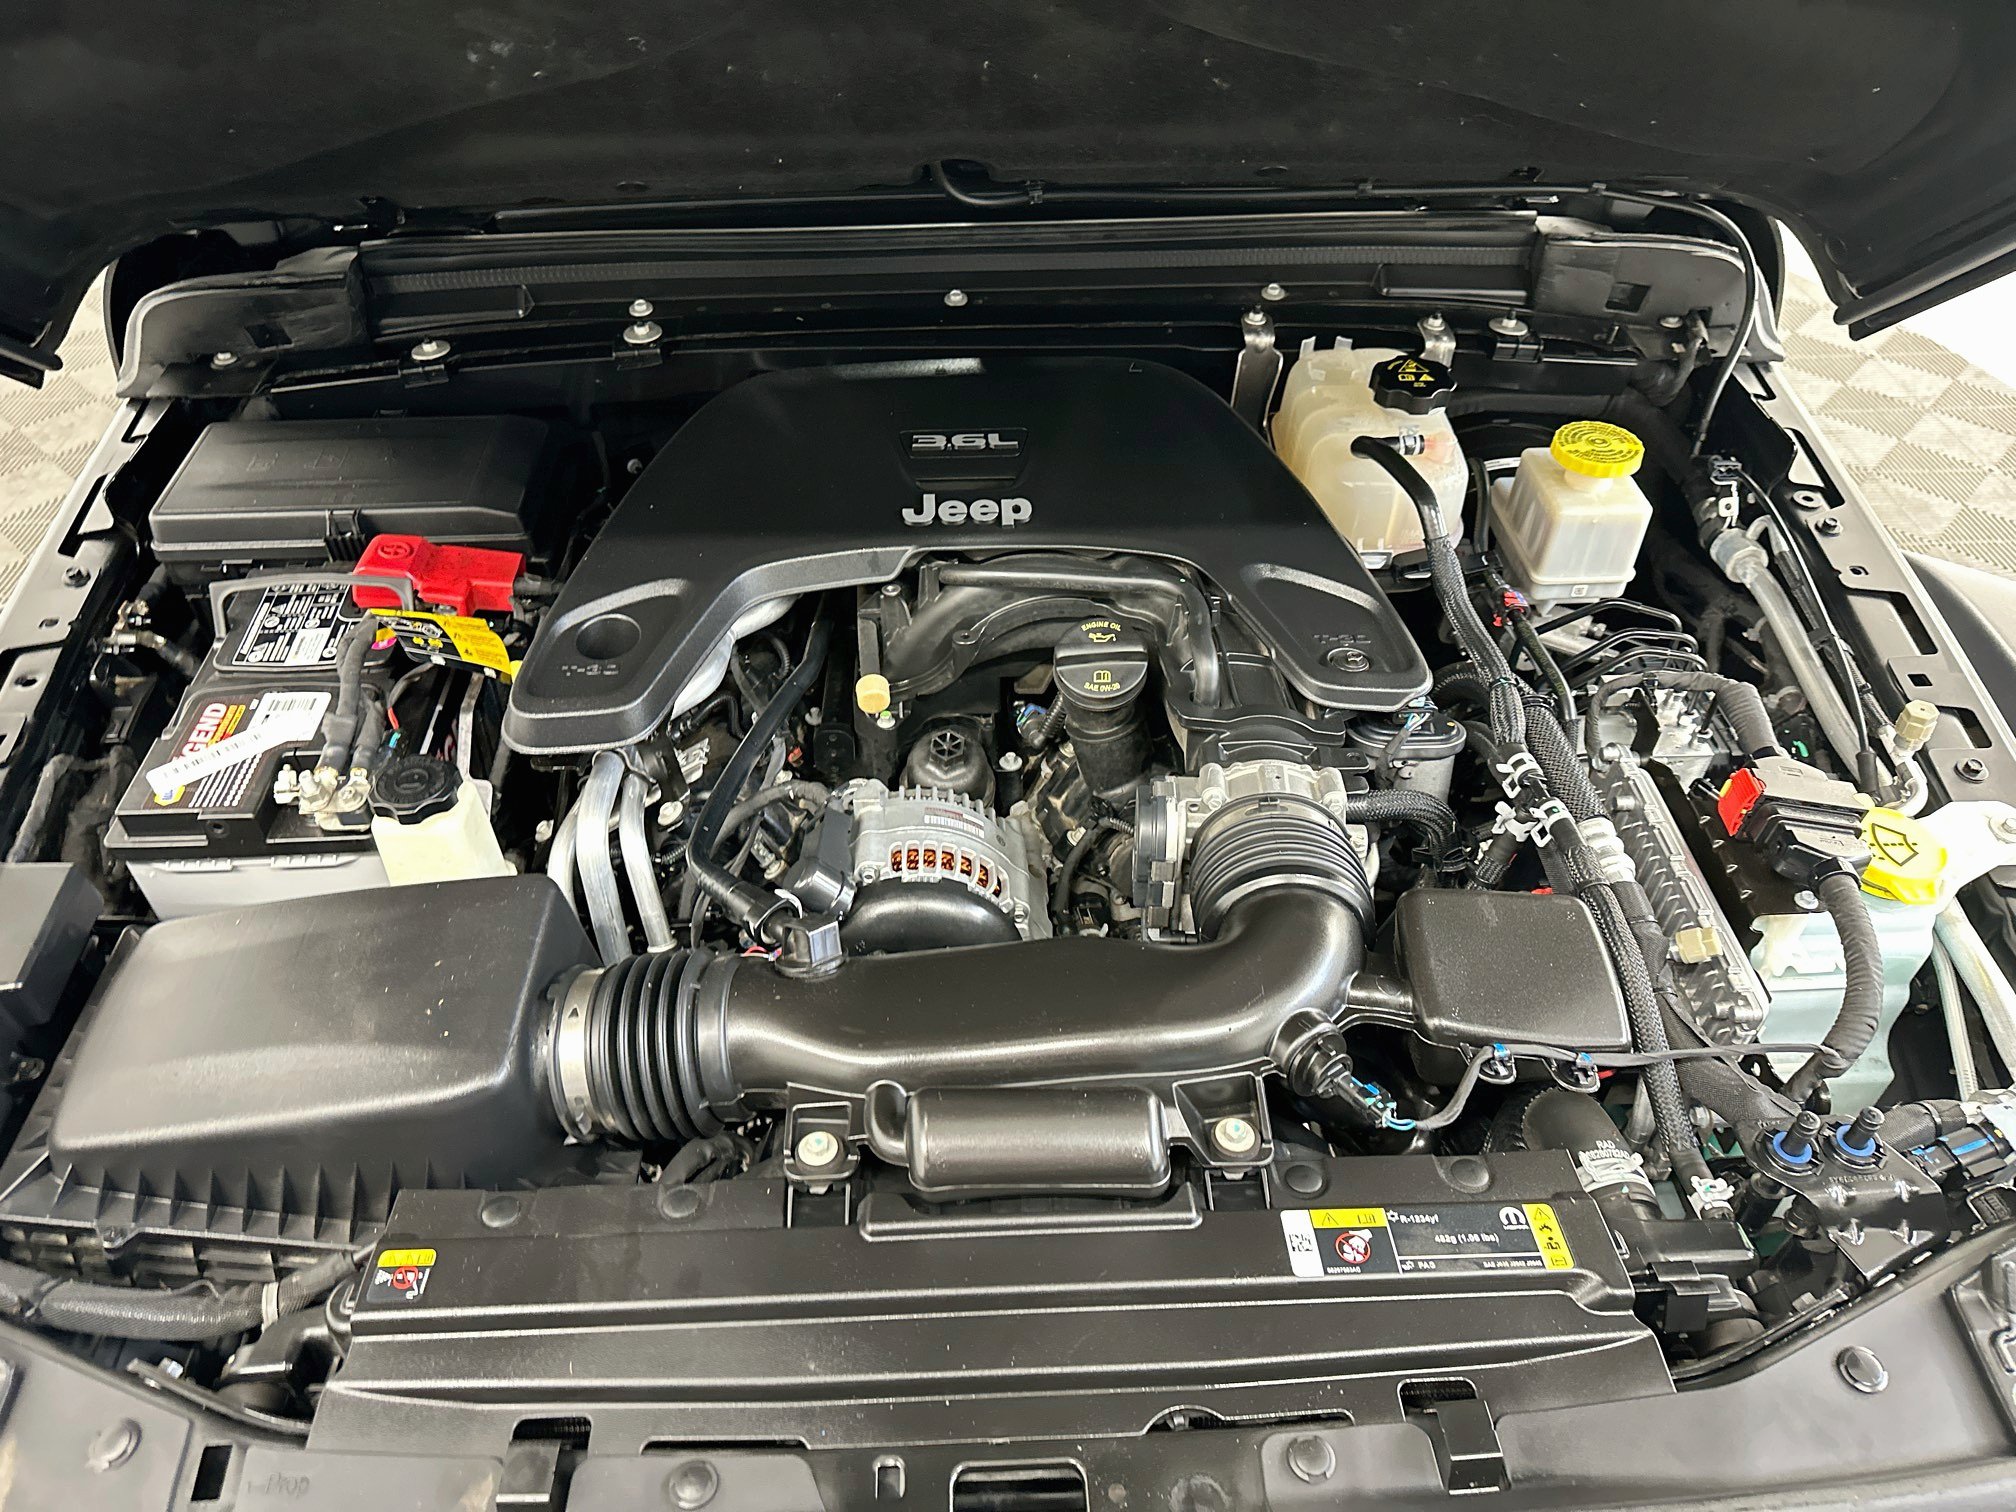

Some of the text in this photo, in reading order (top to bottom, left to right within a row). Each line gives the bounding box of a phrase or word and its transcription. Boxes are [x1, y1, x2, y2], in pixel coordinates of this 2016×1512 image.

[911, 432, 1019, 451] 3.6L
[901, 493, 1033, 528] Jeep
[1081, 621, 1121, 631] ENGINE OIL
[173, 702, 228, 761] GEND
[1596, 1140, 1615, 1149] RAD
[1399, 1213, 1439, 1225] R-1234yf
